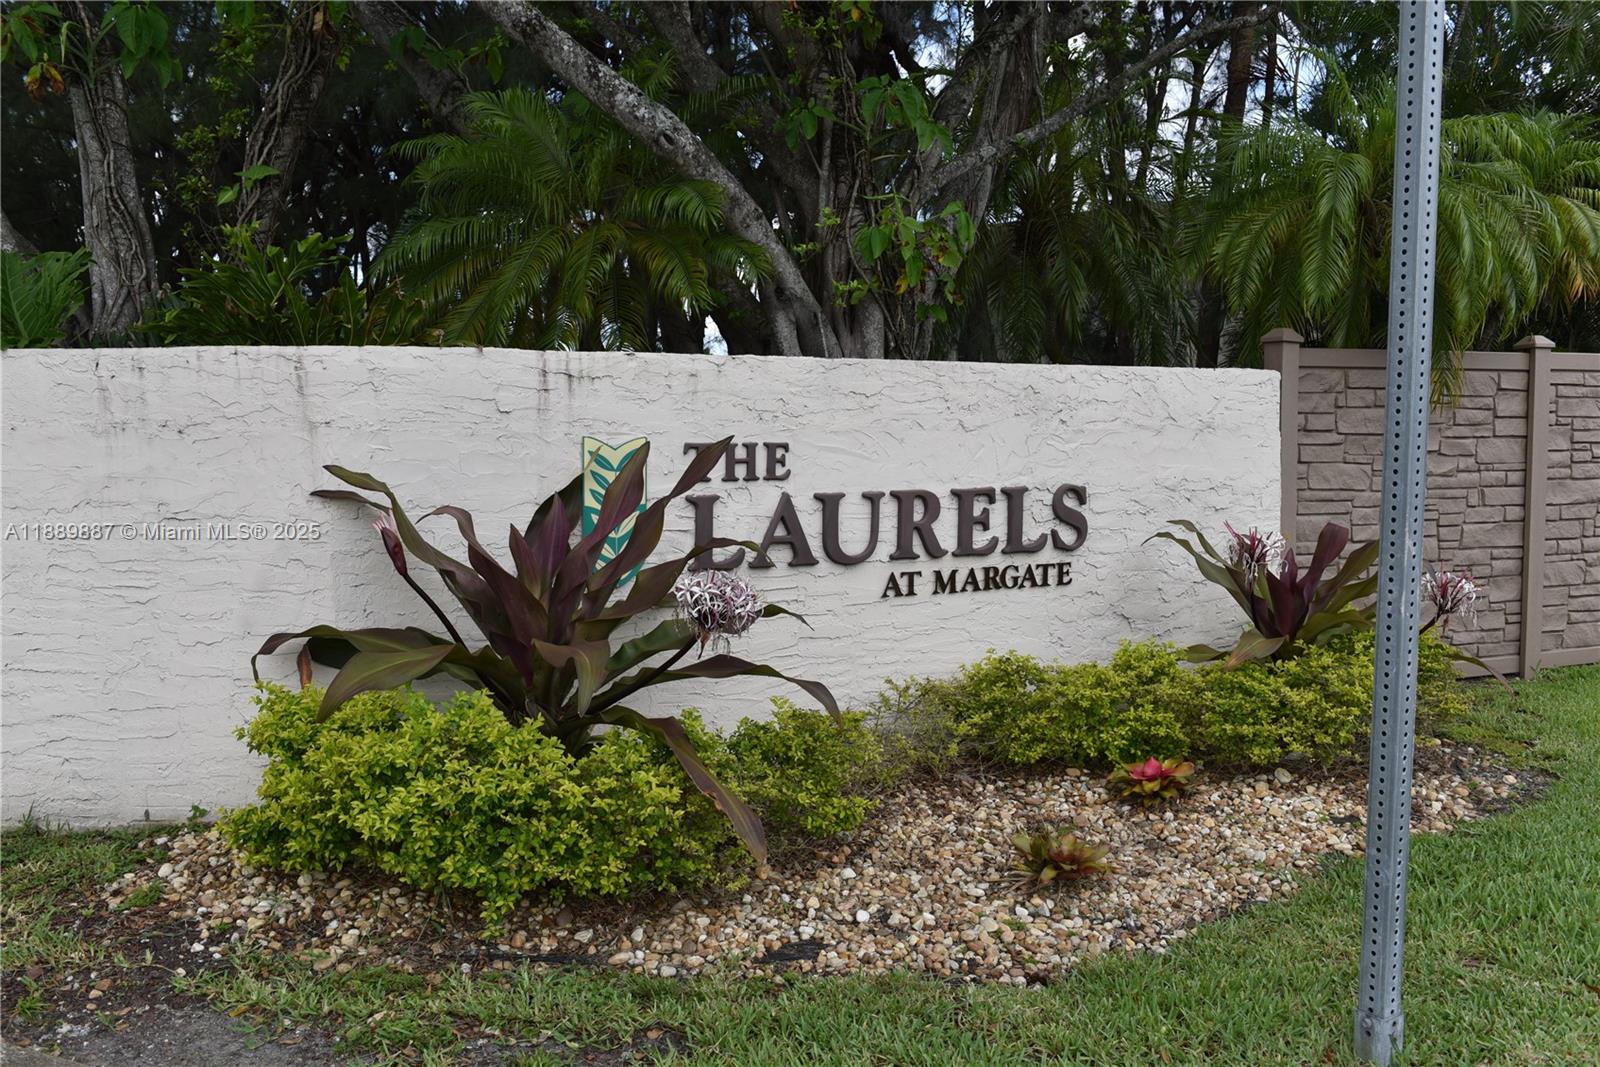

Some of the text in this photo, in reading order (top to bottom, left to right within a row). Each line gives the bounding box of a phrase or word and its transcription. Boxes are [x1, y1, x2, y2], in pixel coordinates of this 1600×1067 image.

[685, 483, 1088, 571] LAURELS
[881, 562, 1073, 599] AT MARGATE
